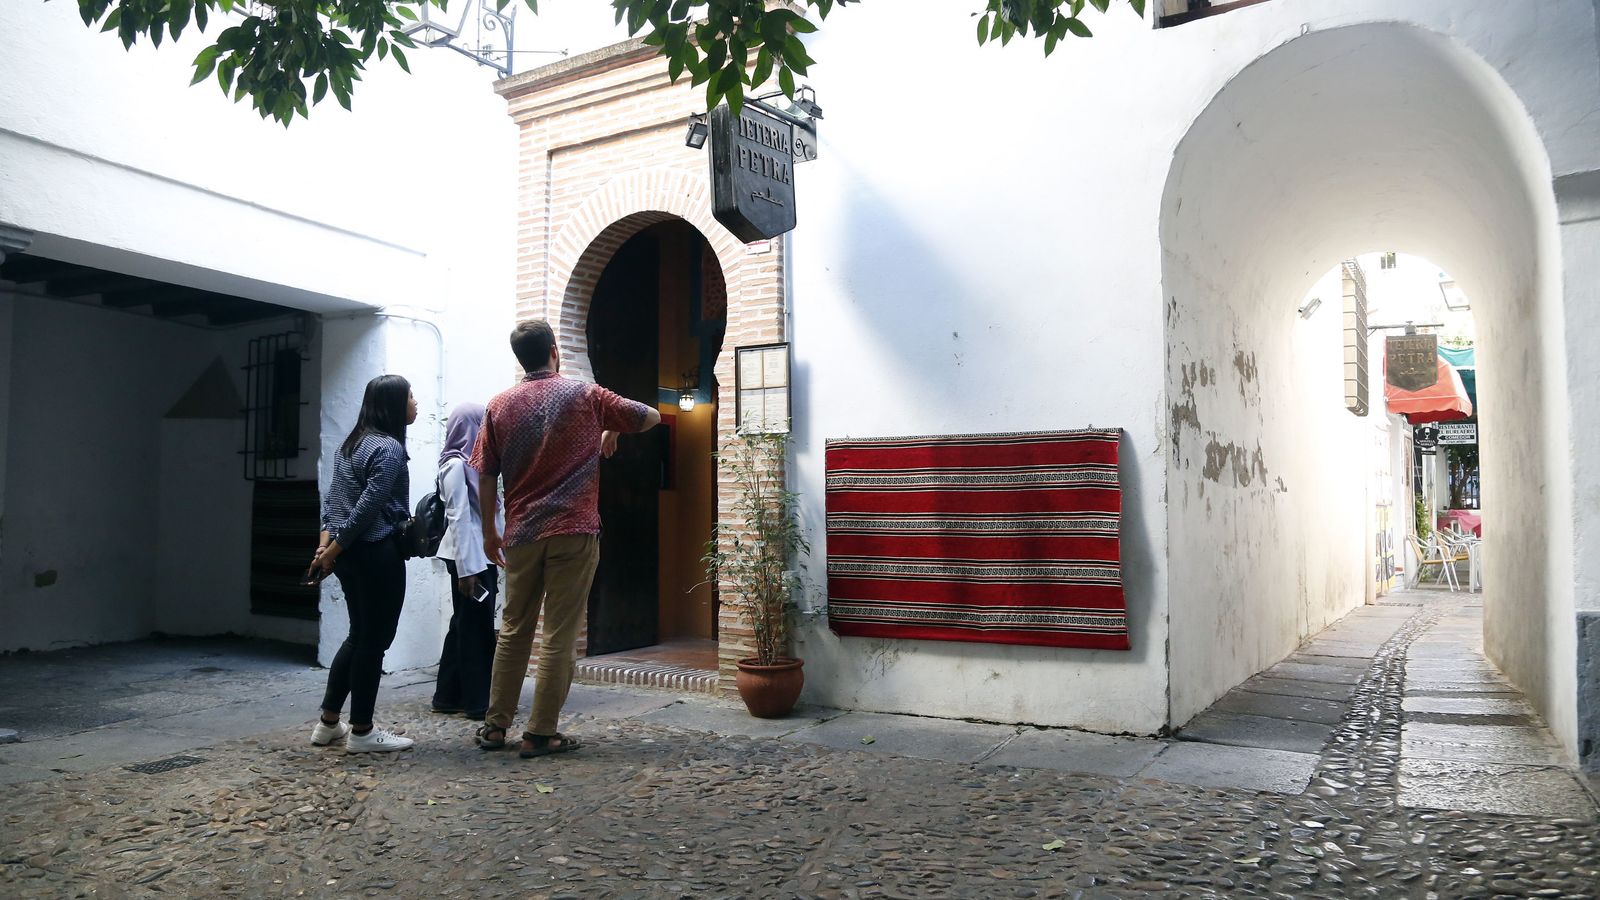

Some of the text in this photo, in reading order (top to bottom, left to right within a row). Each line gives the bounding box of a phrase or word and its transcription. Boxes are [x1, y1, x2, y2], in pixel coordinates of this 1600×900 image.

[739, 115, 791, 155] TETERIA
[737, 144, 791, 185] PETRA
[1389, 352, 1434, 364] PETRA
